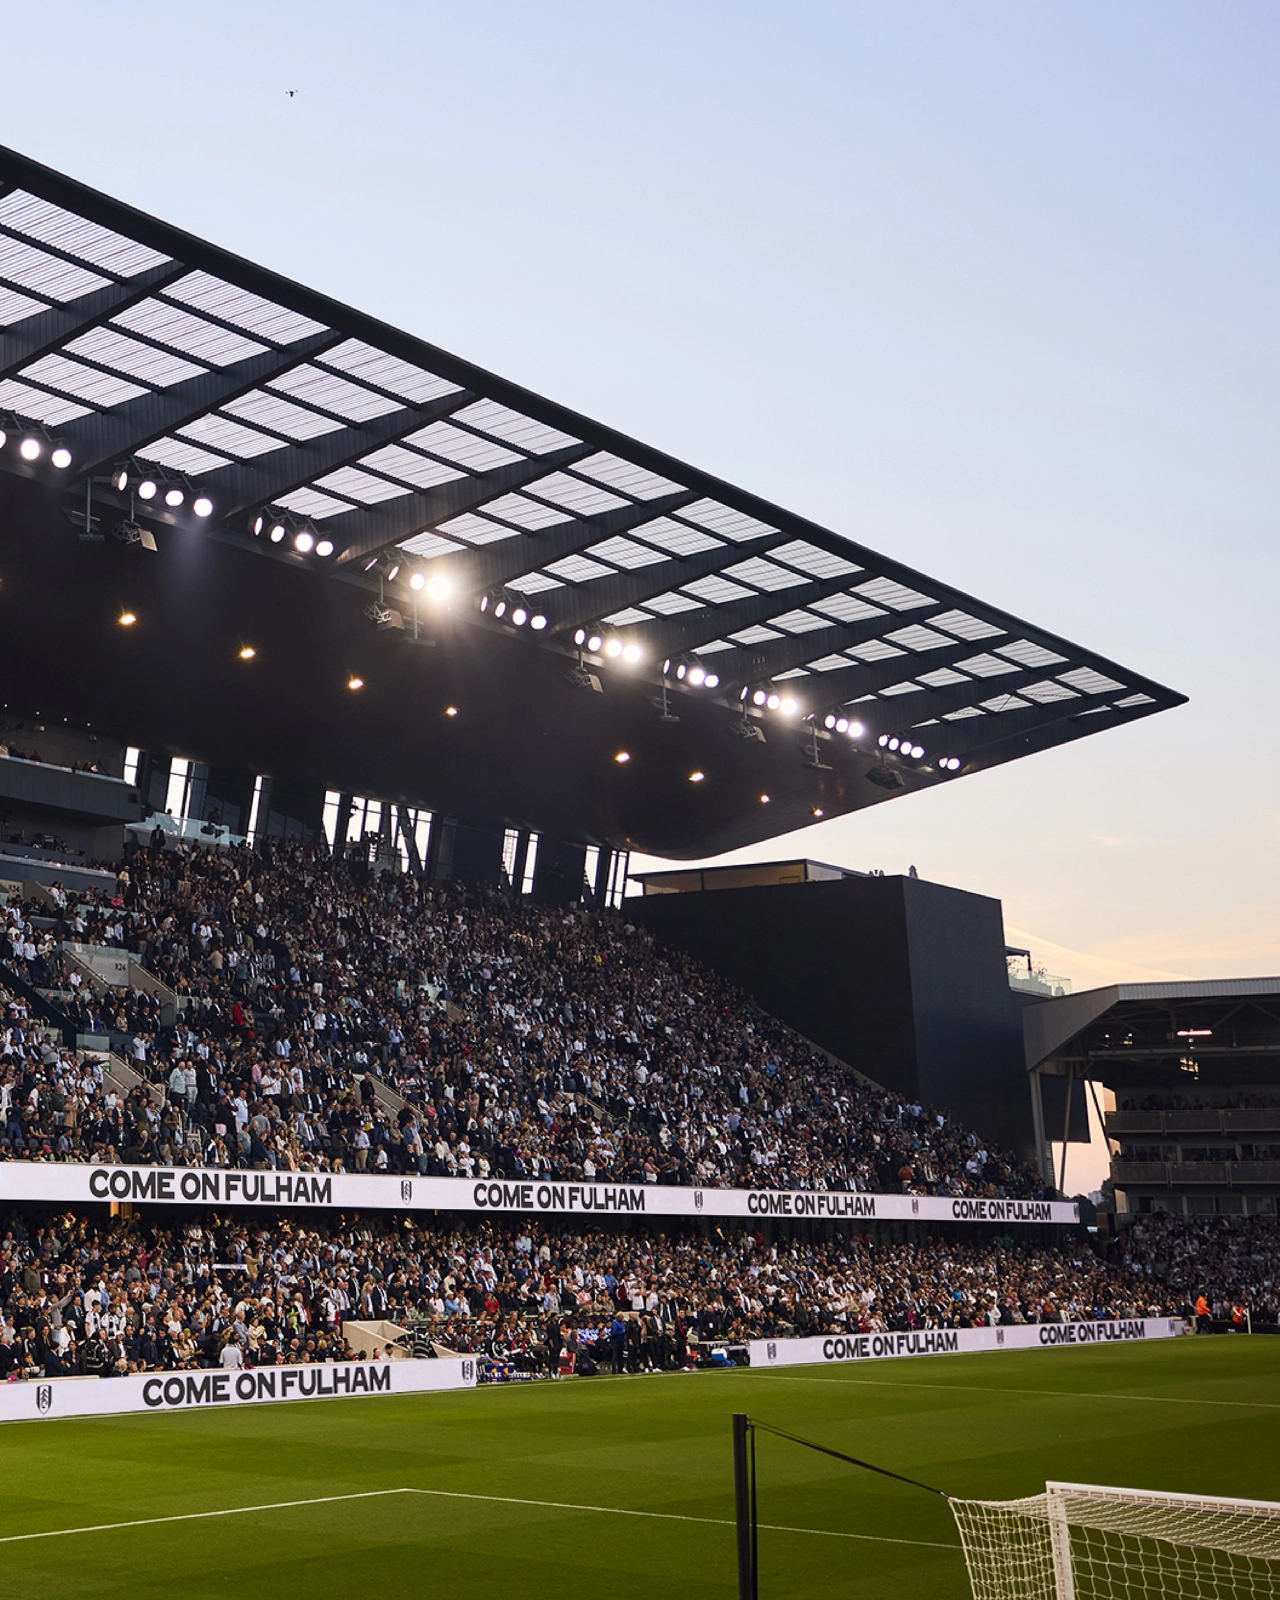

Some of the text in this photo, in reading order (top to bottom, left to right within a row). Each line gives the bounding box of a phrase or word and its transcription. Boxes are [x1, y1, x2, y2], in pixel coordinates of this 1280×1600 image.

[114, 962, 127, 972] R24
[89, 1169, 332, 1204] COME ON FULHAM
[473, 1183, 646, 1211] COME ON FULHAM
[747, 1193, 876, 1216] COME ON FULHAM
[952, 1200, 1052, 1222] COME ON FULHAM
[822, 1331, 958, 1360] COME ON FULHAM
[1039, 1319, 1146, 1345] COME ON FULHAM
[142, 1365, 391, 1407] COME ON FULHAM
